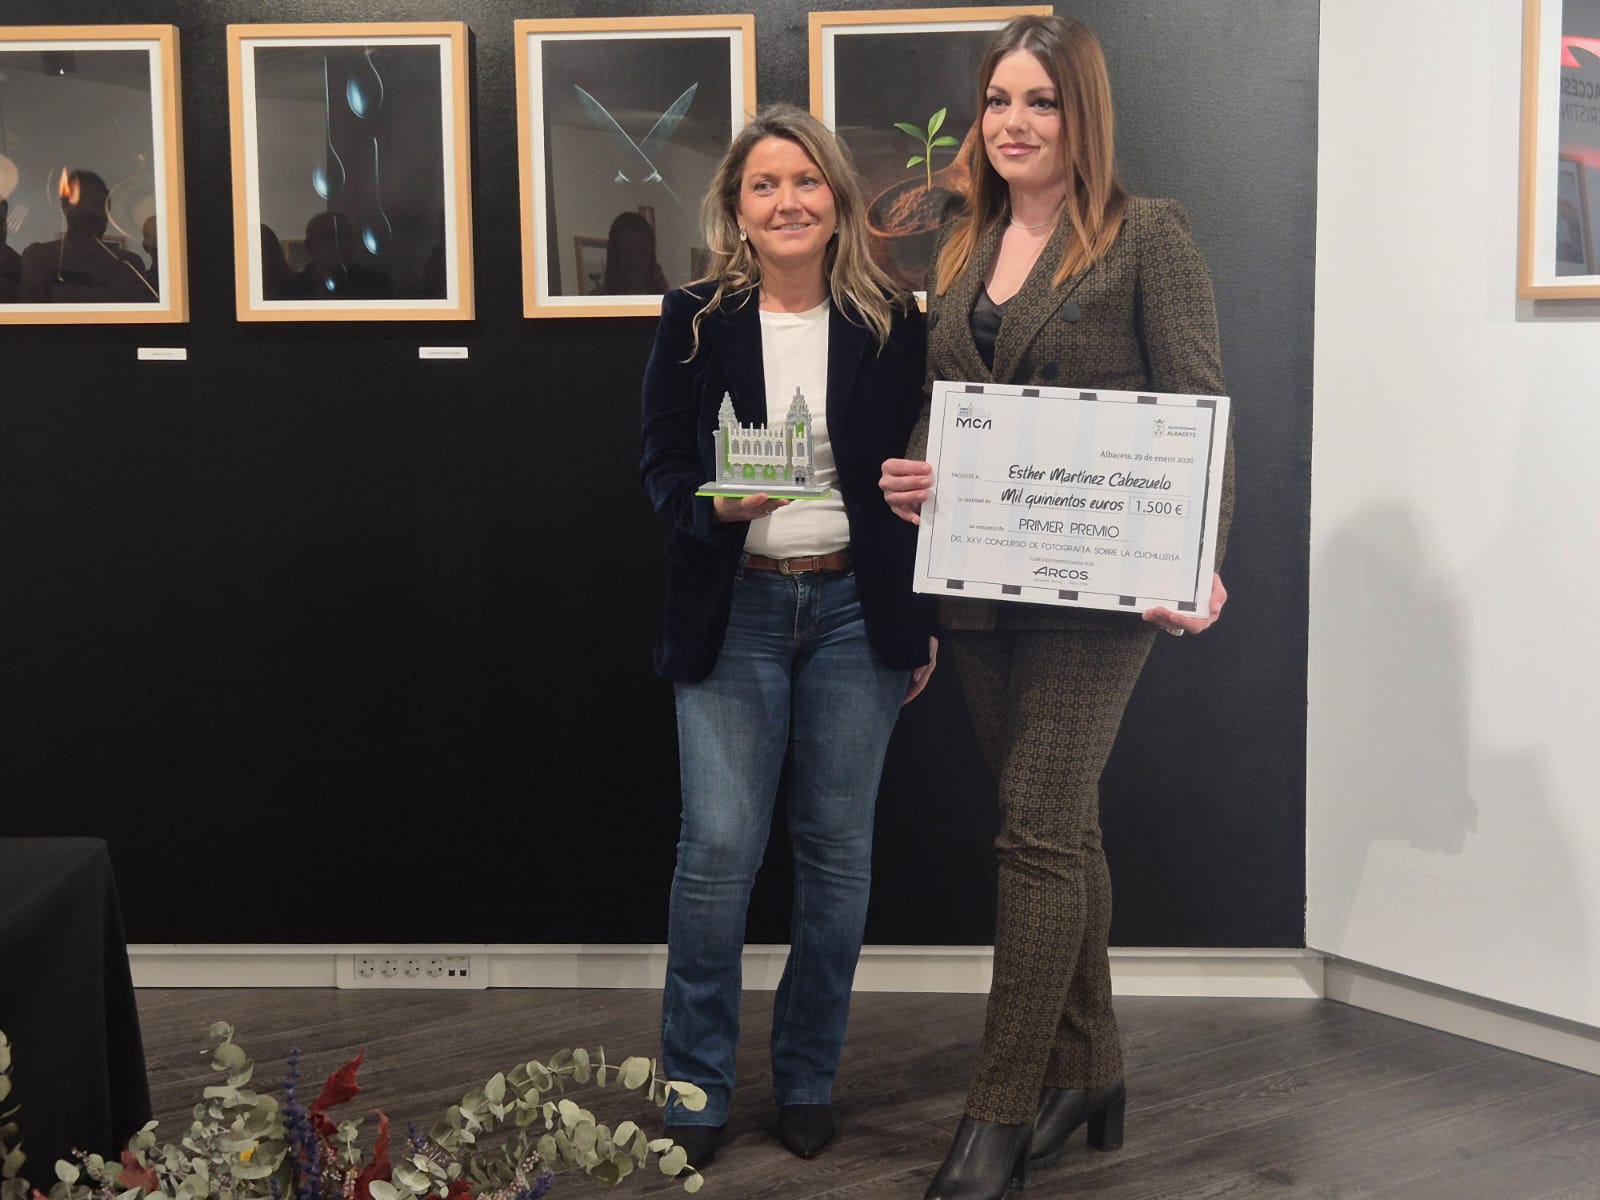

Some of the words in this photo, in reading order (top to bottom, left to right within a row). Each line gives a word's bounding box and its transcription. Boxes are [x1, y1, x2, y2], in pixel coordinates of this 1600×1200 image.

[956, 417, 992, 430] MCA
[1144, 453, 1153, 461] de
[1154, 455, 1175, 463] enero
[1008, 464, 1046, 481] Esther
[1049, 468, 1105, 486] Martínez
[1108, 471, 1172, 491] Cabezuelo
[1001, 488, 1024, 505] Mil
[1025, 492, 1087, 510] quinientos
[1089, 498, 1124, 511] euros
[1135, 500, 1172, 515] 1.500
[1174, 504, 1184, 516] €
[1018, 518, 1064, 533] PRIMER
[1070, 522, 1120, 538] PREMIO
[966, 536, 982, 544] XXV
[985, 538, 1026, 548] CONCURSO
[1094, 547, 1117, 556] SOBRE
[1120, 549, 1130, 557] LA
[1032, 566, 1089, 581] ARCOS
